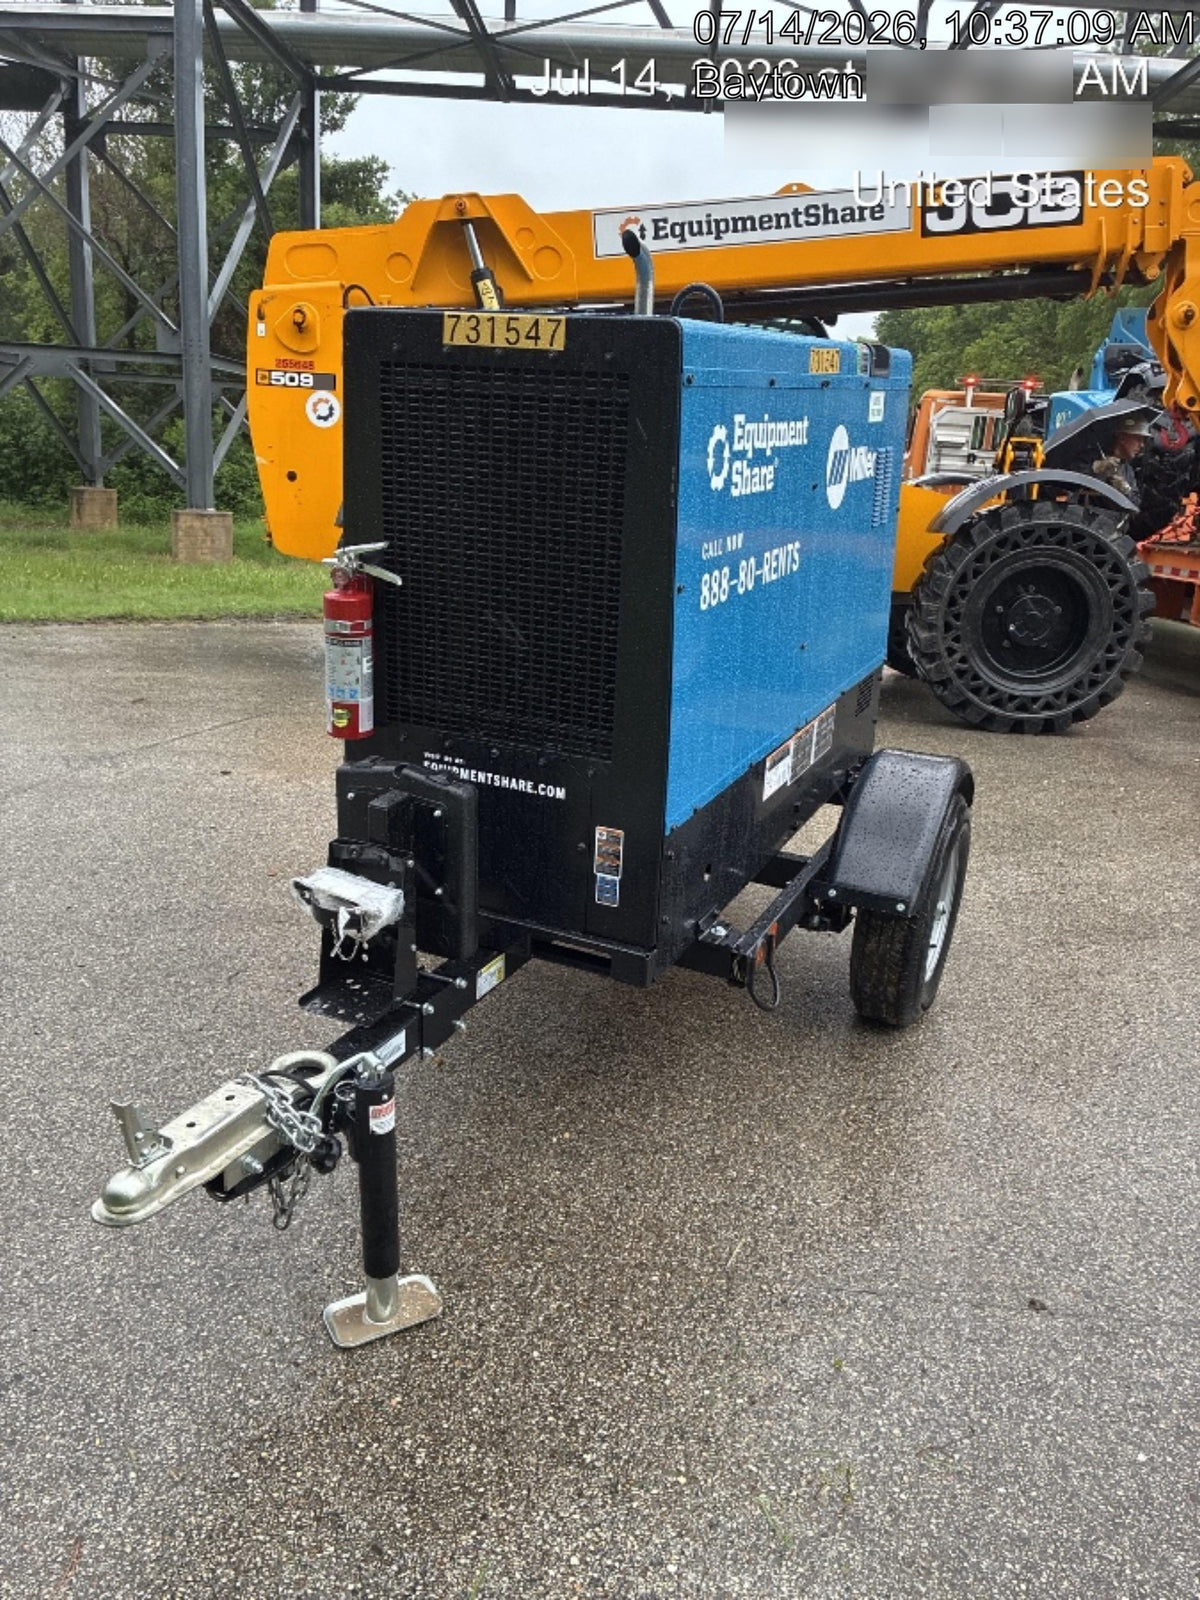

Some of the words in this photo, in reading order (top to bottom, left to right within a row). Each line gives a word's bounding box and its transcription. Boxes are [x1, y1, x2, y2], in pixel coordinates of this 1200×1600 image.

[651, 203, 885, 243] EquipmentShare
[924, 174, 1082, 232] JCB
[447, 314, 563, 347] 731547
[270, 371, 314, 388] 509
[732, 413, 809, 459] Equipment
[731, 460, 775, 497] Share
[700, 540, 801, 611] 888-80-RENTS
